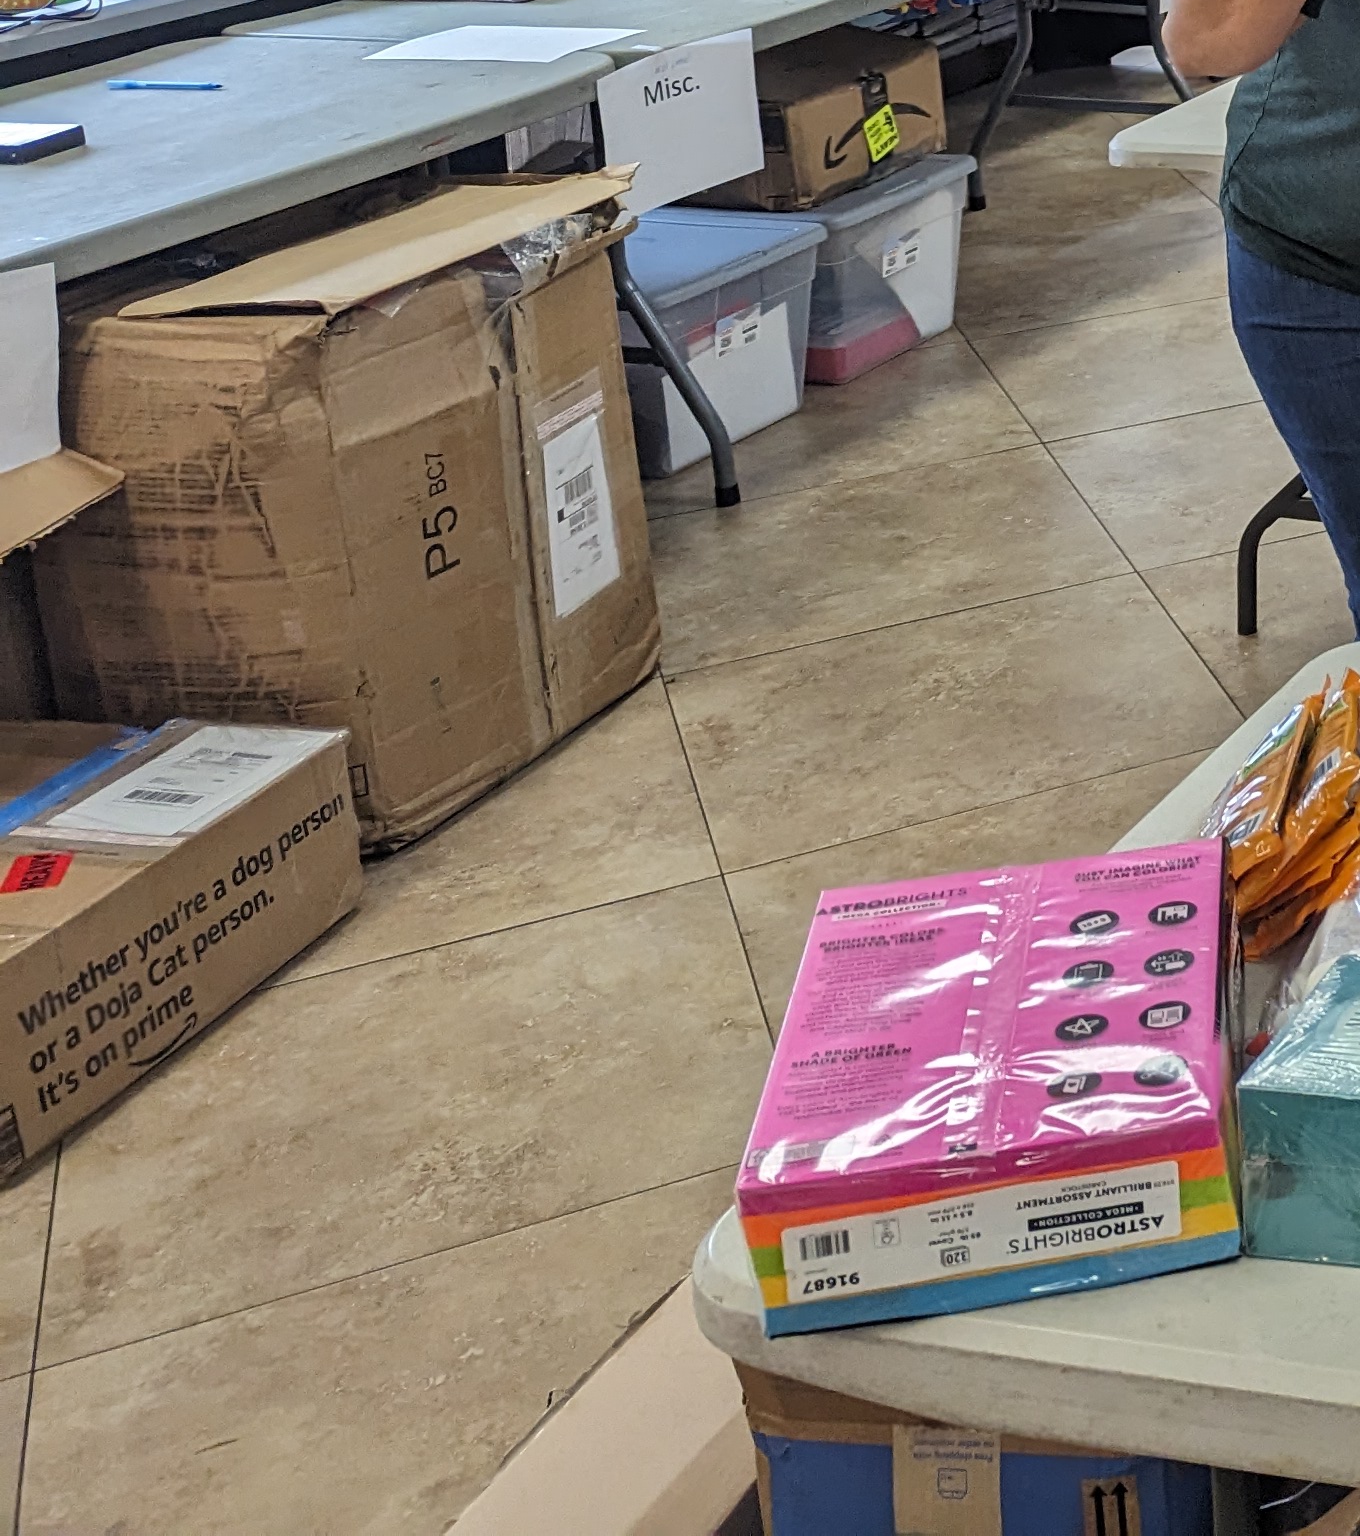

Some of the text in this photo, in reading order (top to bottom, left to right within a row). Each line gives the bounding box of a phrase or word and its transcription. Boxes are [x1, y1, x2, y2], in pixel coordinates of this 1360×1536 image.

[643, 75, 701, 107] Misc.
[422, 506, 461, 581] P5
[17, 794, 346, 1036] Whether you're a dog person
[816, 886, 969, 917] ASTROBRIGHTS
[28, 885, 276, 1075] or a Doja Cat person.
[37, 984, 194, 1113] It's on prime
[824, 1042, 896, 1057] BRIGHTER
[841, 1052, 862, 1064] OF
[864, 1046, 913, 1060] GREEN
[1015, 1181, 1152, 1212] BRILLIANT ASSORTMENT
[1036, 1205, 1140, 1227] MEGA COLLECTION
[1008, 1214, 1165, 1255] ASTROBRIGHTS
[946, 1250, 967, 1265] 320
[802, 1271, 861, 1295] 91687
